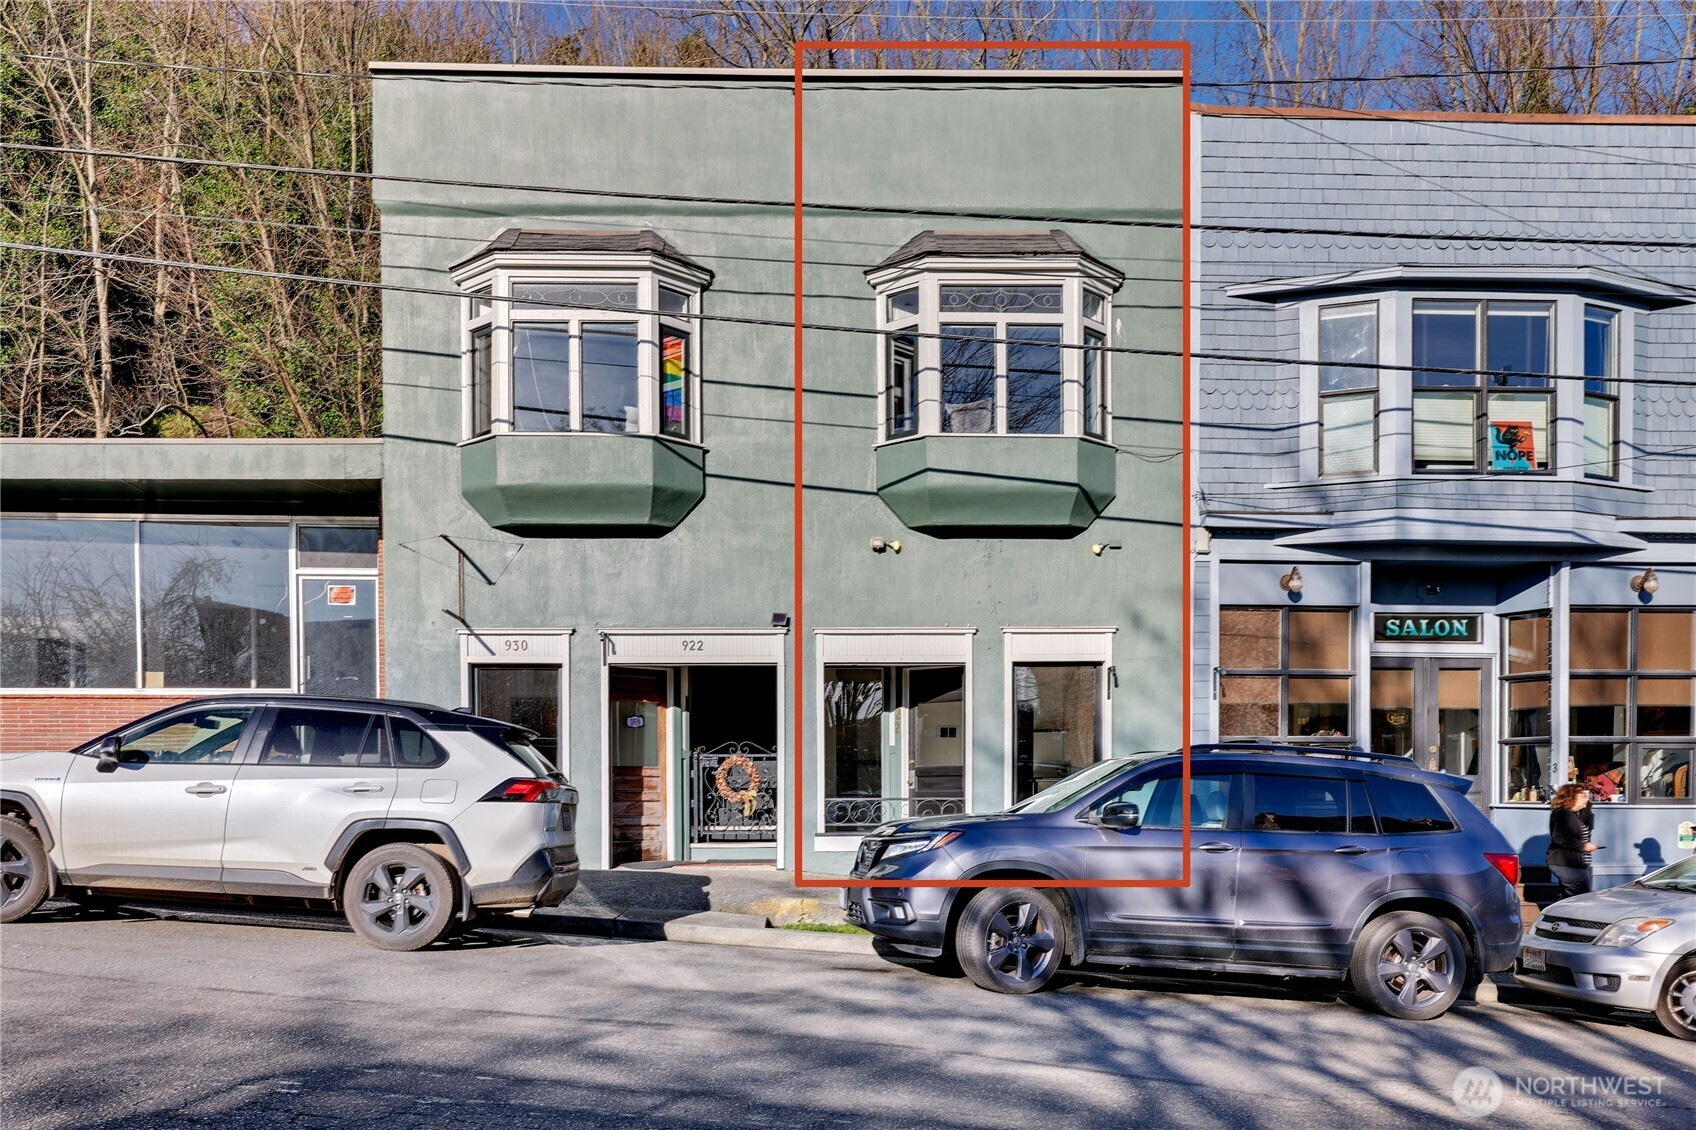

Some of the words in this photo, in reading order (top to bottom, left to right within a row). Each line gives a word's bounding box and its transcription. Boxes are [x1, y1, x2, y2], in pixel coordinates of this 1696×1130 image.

[1495, 449, 1533, 461] NOPE
[1385, 619, 1468, 636] SALON
[505, 640, 528, 651] 930
[682, 640, 704, 651] 922
